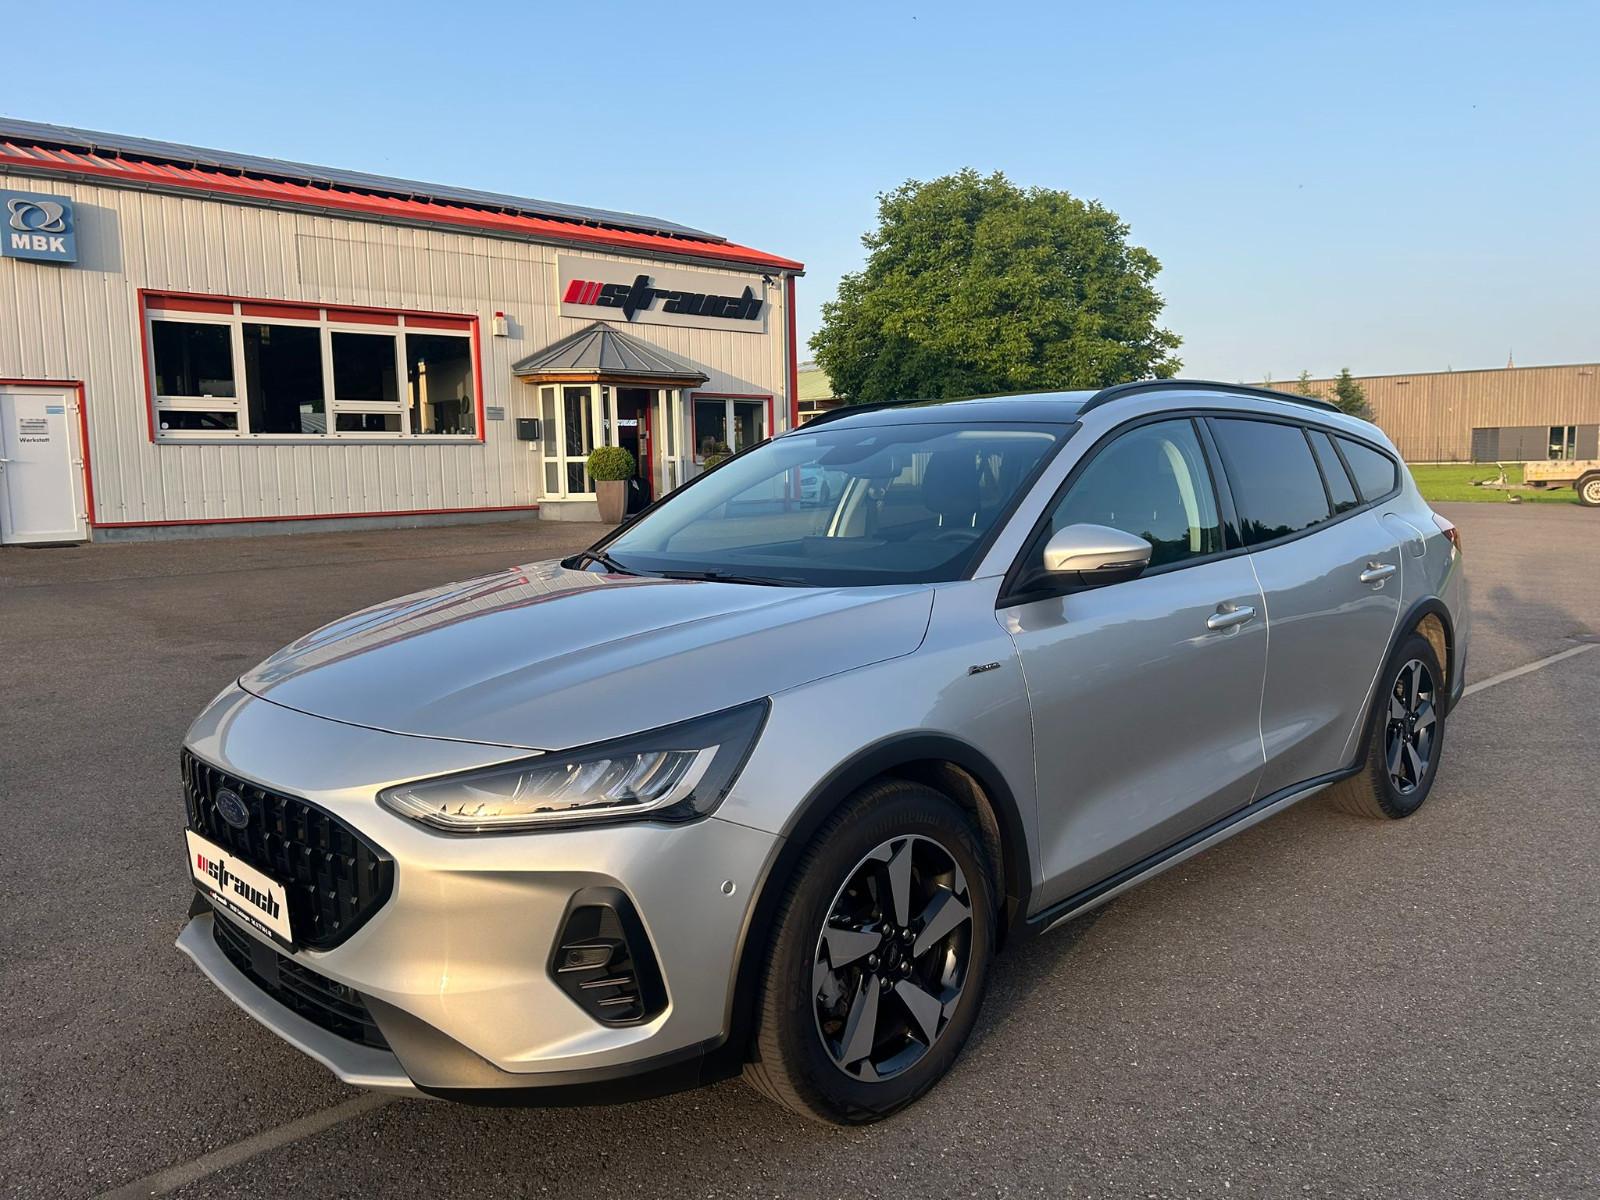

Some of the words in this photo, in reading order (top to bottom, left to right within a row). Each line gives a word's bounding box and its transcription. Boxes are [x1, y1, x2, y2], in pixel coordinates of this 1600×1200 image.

[11, 233, 66, 253] MBK
[596, 274, 764, 322] strauch
[208, 859, 280, 920] strauch
